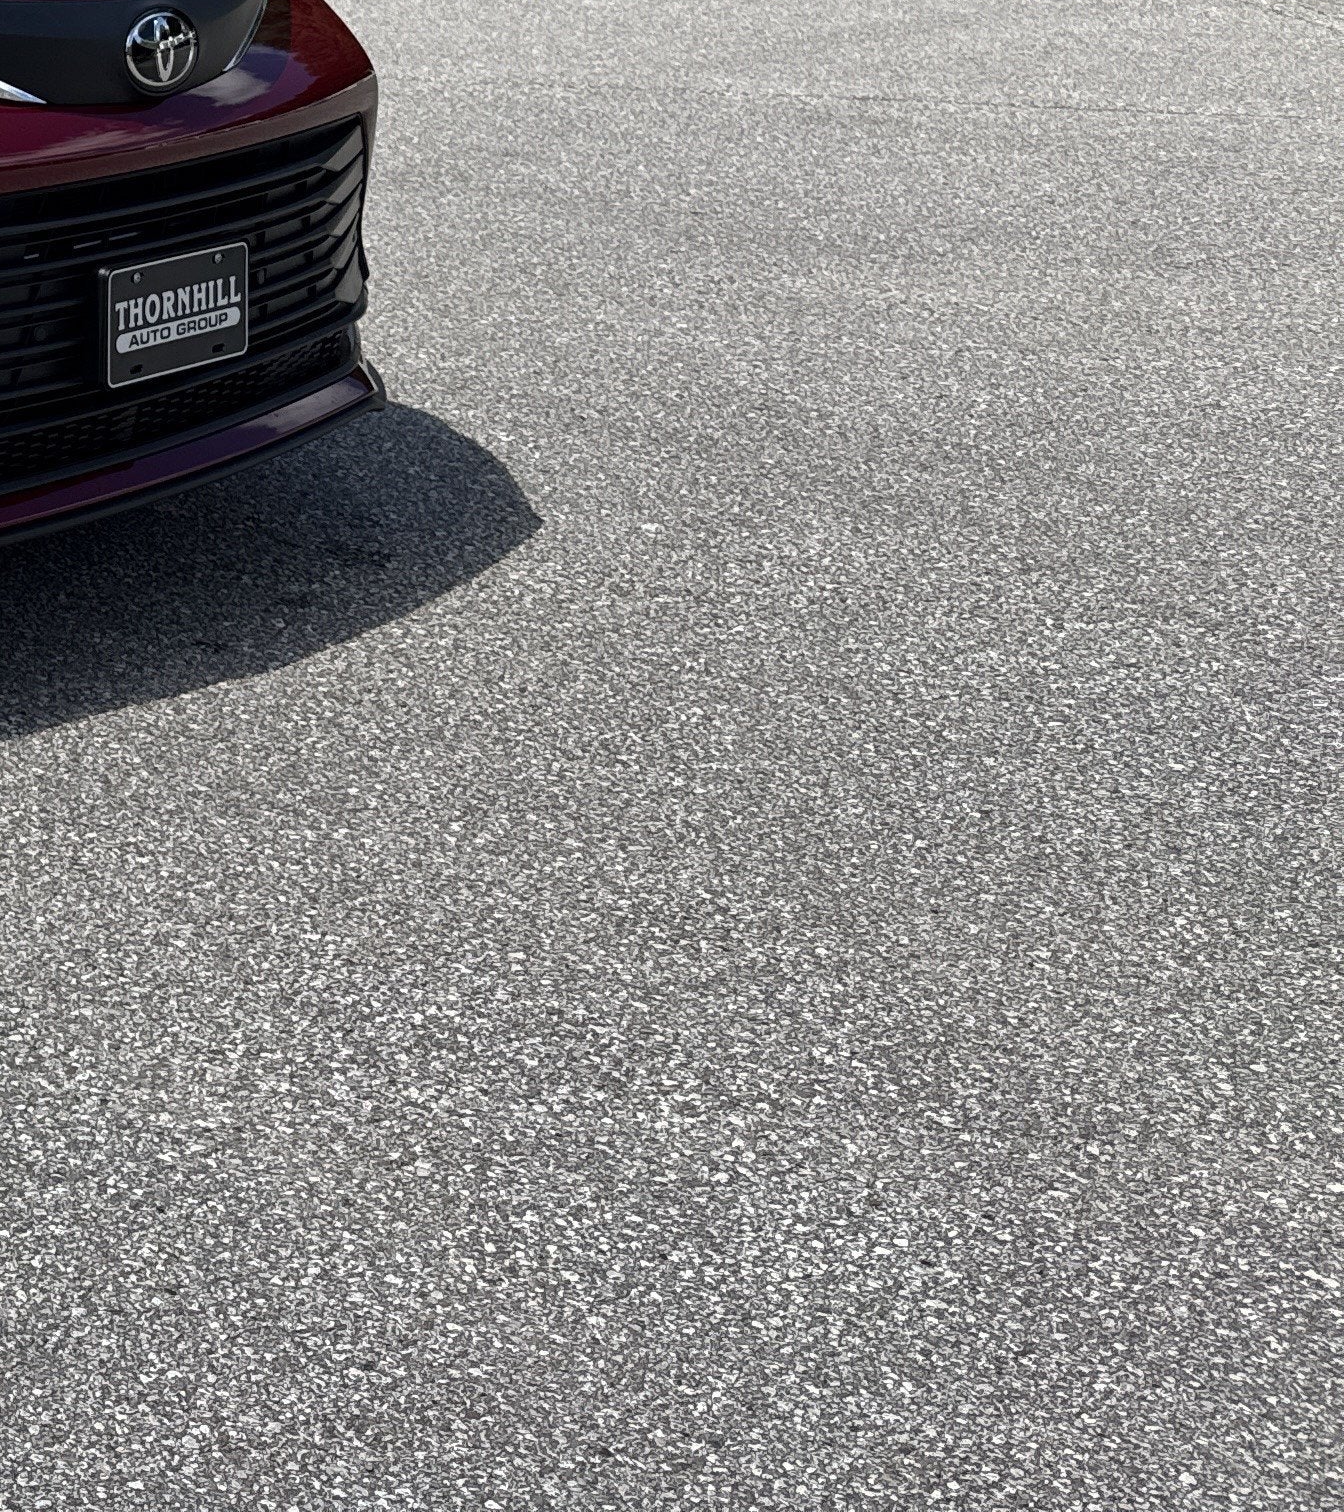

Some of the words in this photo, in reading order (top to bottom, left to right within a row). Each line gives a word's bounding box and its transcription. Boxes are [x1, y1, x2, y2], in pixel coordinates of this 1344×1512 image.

[115, 275, 242, 331] THORNHILL
[128, 326, 171, 349] AUTO
[176, 312, 228, 336] GROUP
